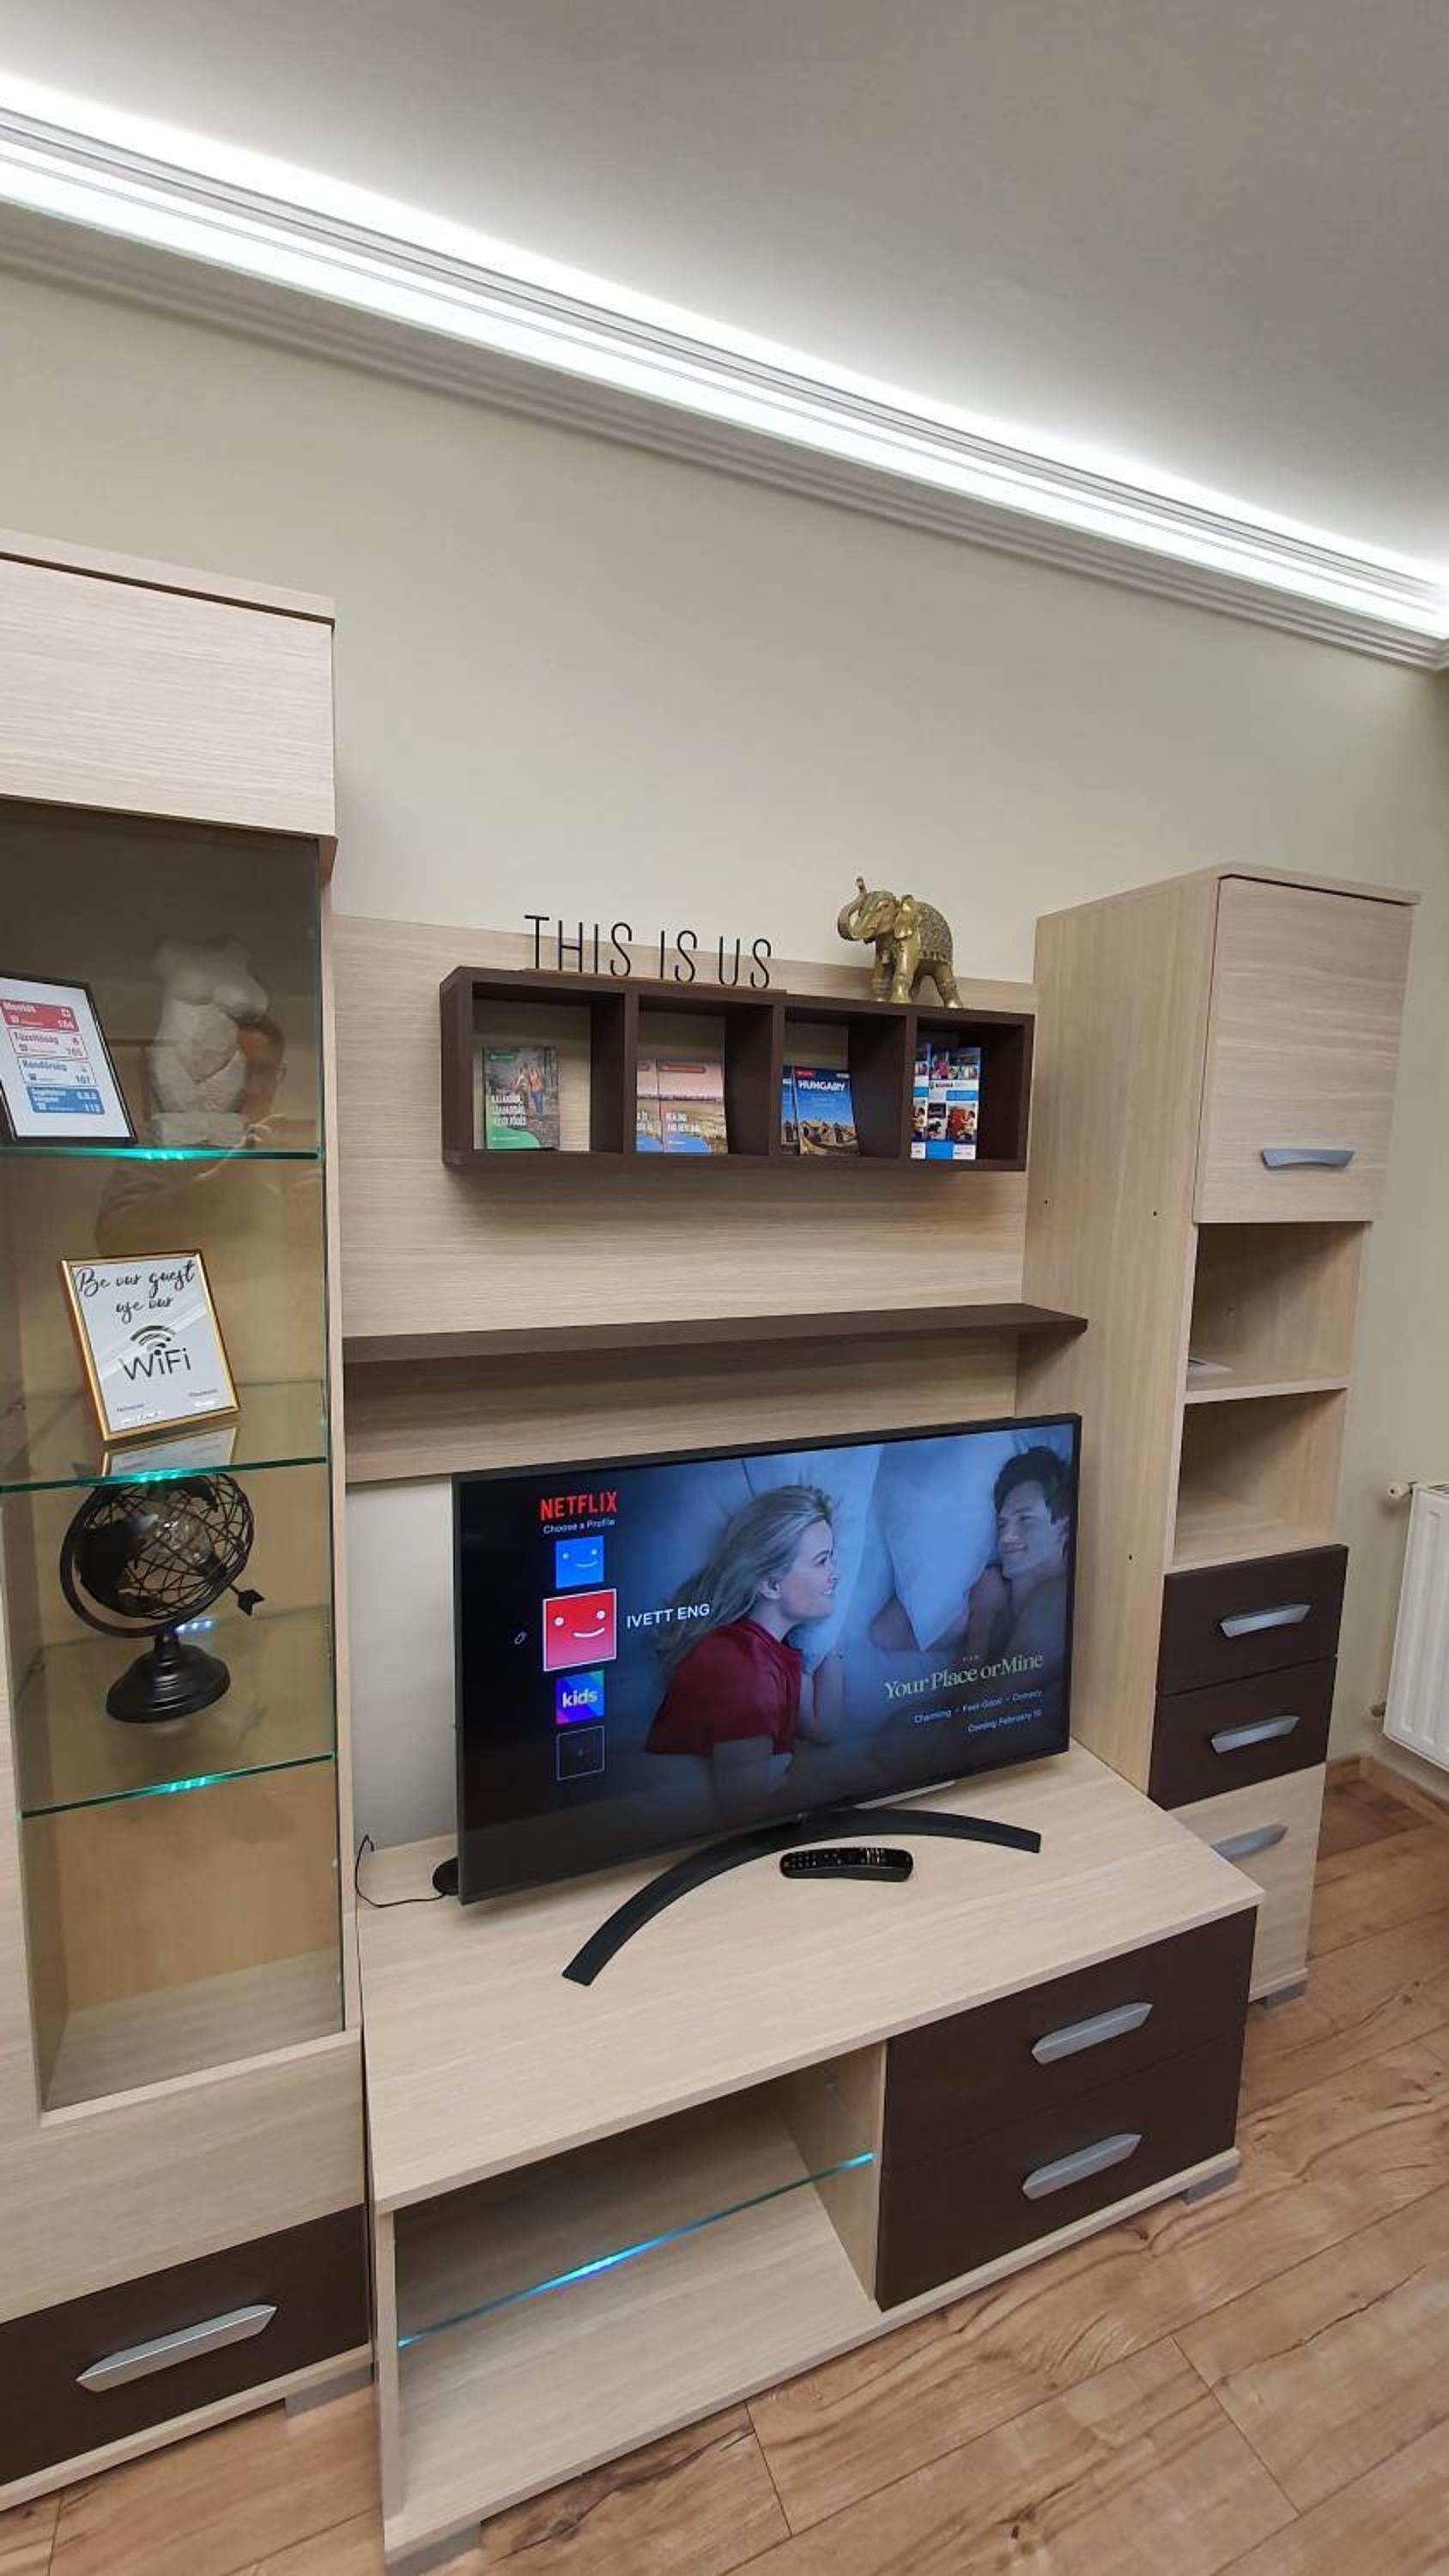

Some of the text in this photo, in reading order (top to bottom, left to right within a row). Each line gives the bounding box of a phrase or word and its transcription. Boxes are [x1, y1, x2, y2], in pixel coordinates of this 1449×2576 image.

[524, 914, 771, 988] THIS IS US
[797, 1079, 846, 1092] HUNGARY
[76, 1260, 195, 1298] Be our guest
[116, 1297, 173, 1325] use our
[118, 1347, 191, 1381] WiFi
[540, 1491, 618, 1522] NETFLIX
[543, 1522, 577, 1534] Choose
[586, 1517, 615, 1529] Profile
[627, 1603, 710, 1629] IVETT ENG
[563, 1688, 598, 1708] kids
[884, 1679, 930, 1699] Your
[931, 1668, 978, 1691] Place
